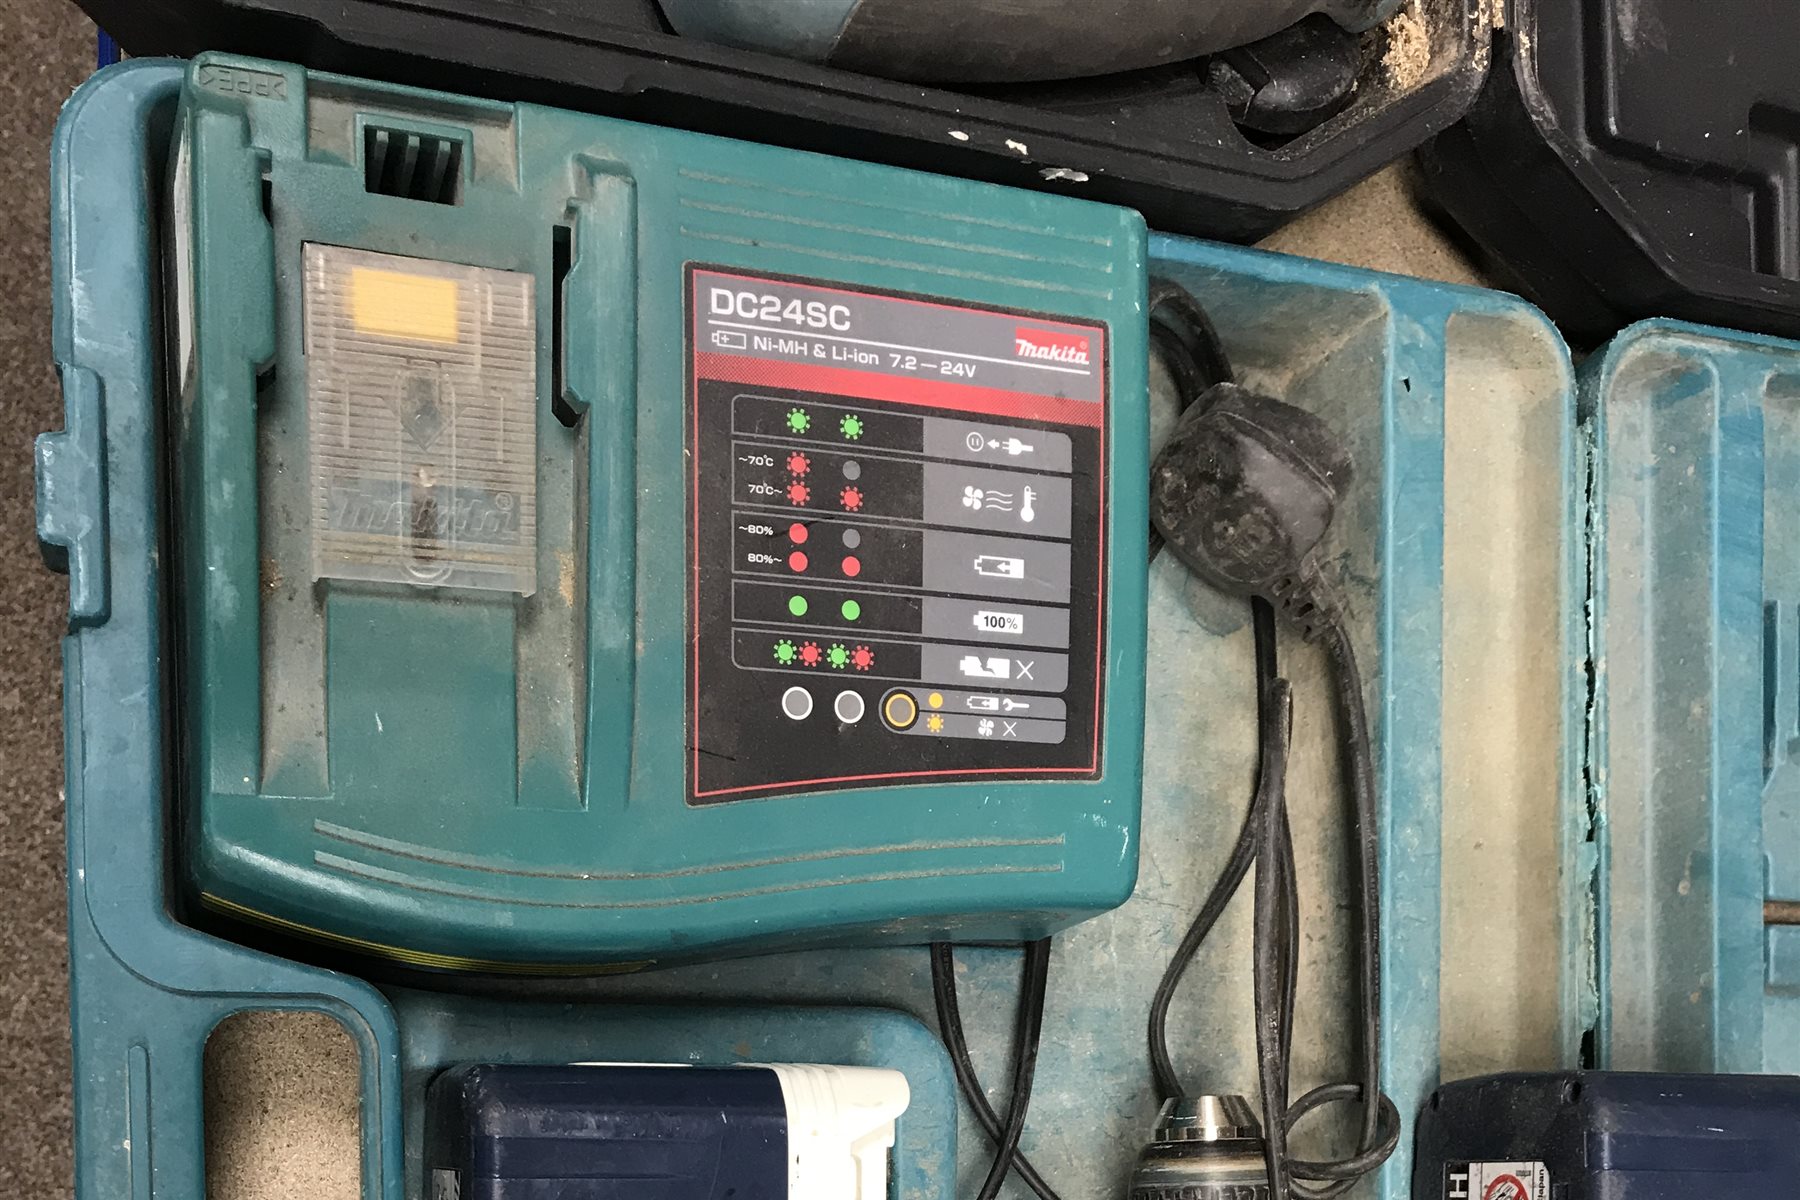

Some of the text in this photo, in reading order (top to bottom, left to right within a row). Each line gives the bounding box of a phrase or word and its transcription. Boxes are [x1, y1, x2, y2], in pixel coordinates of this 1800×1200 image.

[710, 287, 851, 332] DC24SC
[753, 334, 808, 357] Ni-MH
[813, 343, 827, 358] &
[832, 344, 880, 366] Li-ion
[983, 614, 1018, 632] 100%
